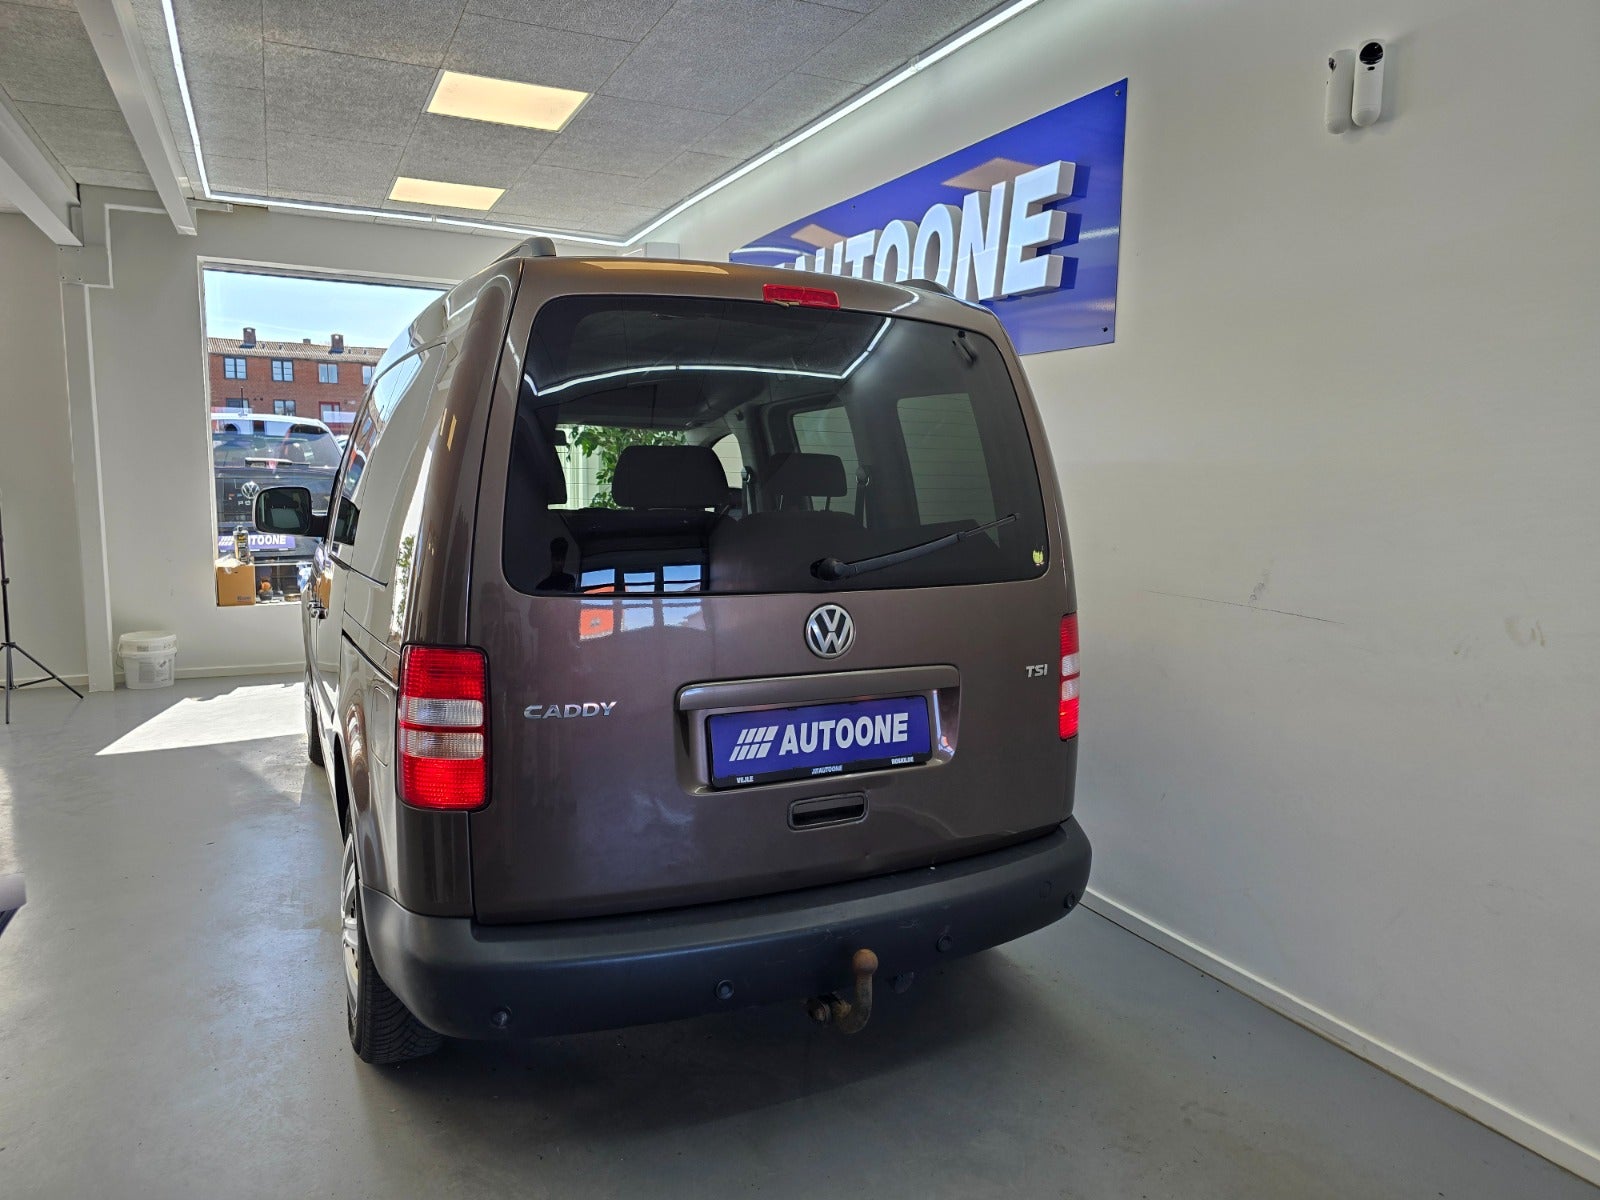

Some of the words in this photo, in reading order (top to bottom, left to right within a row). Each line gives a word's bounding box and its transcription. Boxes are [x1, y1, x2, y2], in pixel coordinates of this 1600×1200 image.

[247, 534, 287, 545] TOONE
[1025, 663, 1048, 678] TSI
[523, 701, 618, 719] CADDY
[778, 712, 909, 756] AUTOONE
[736, 775, 754, 784] VEJLE
